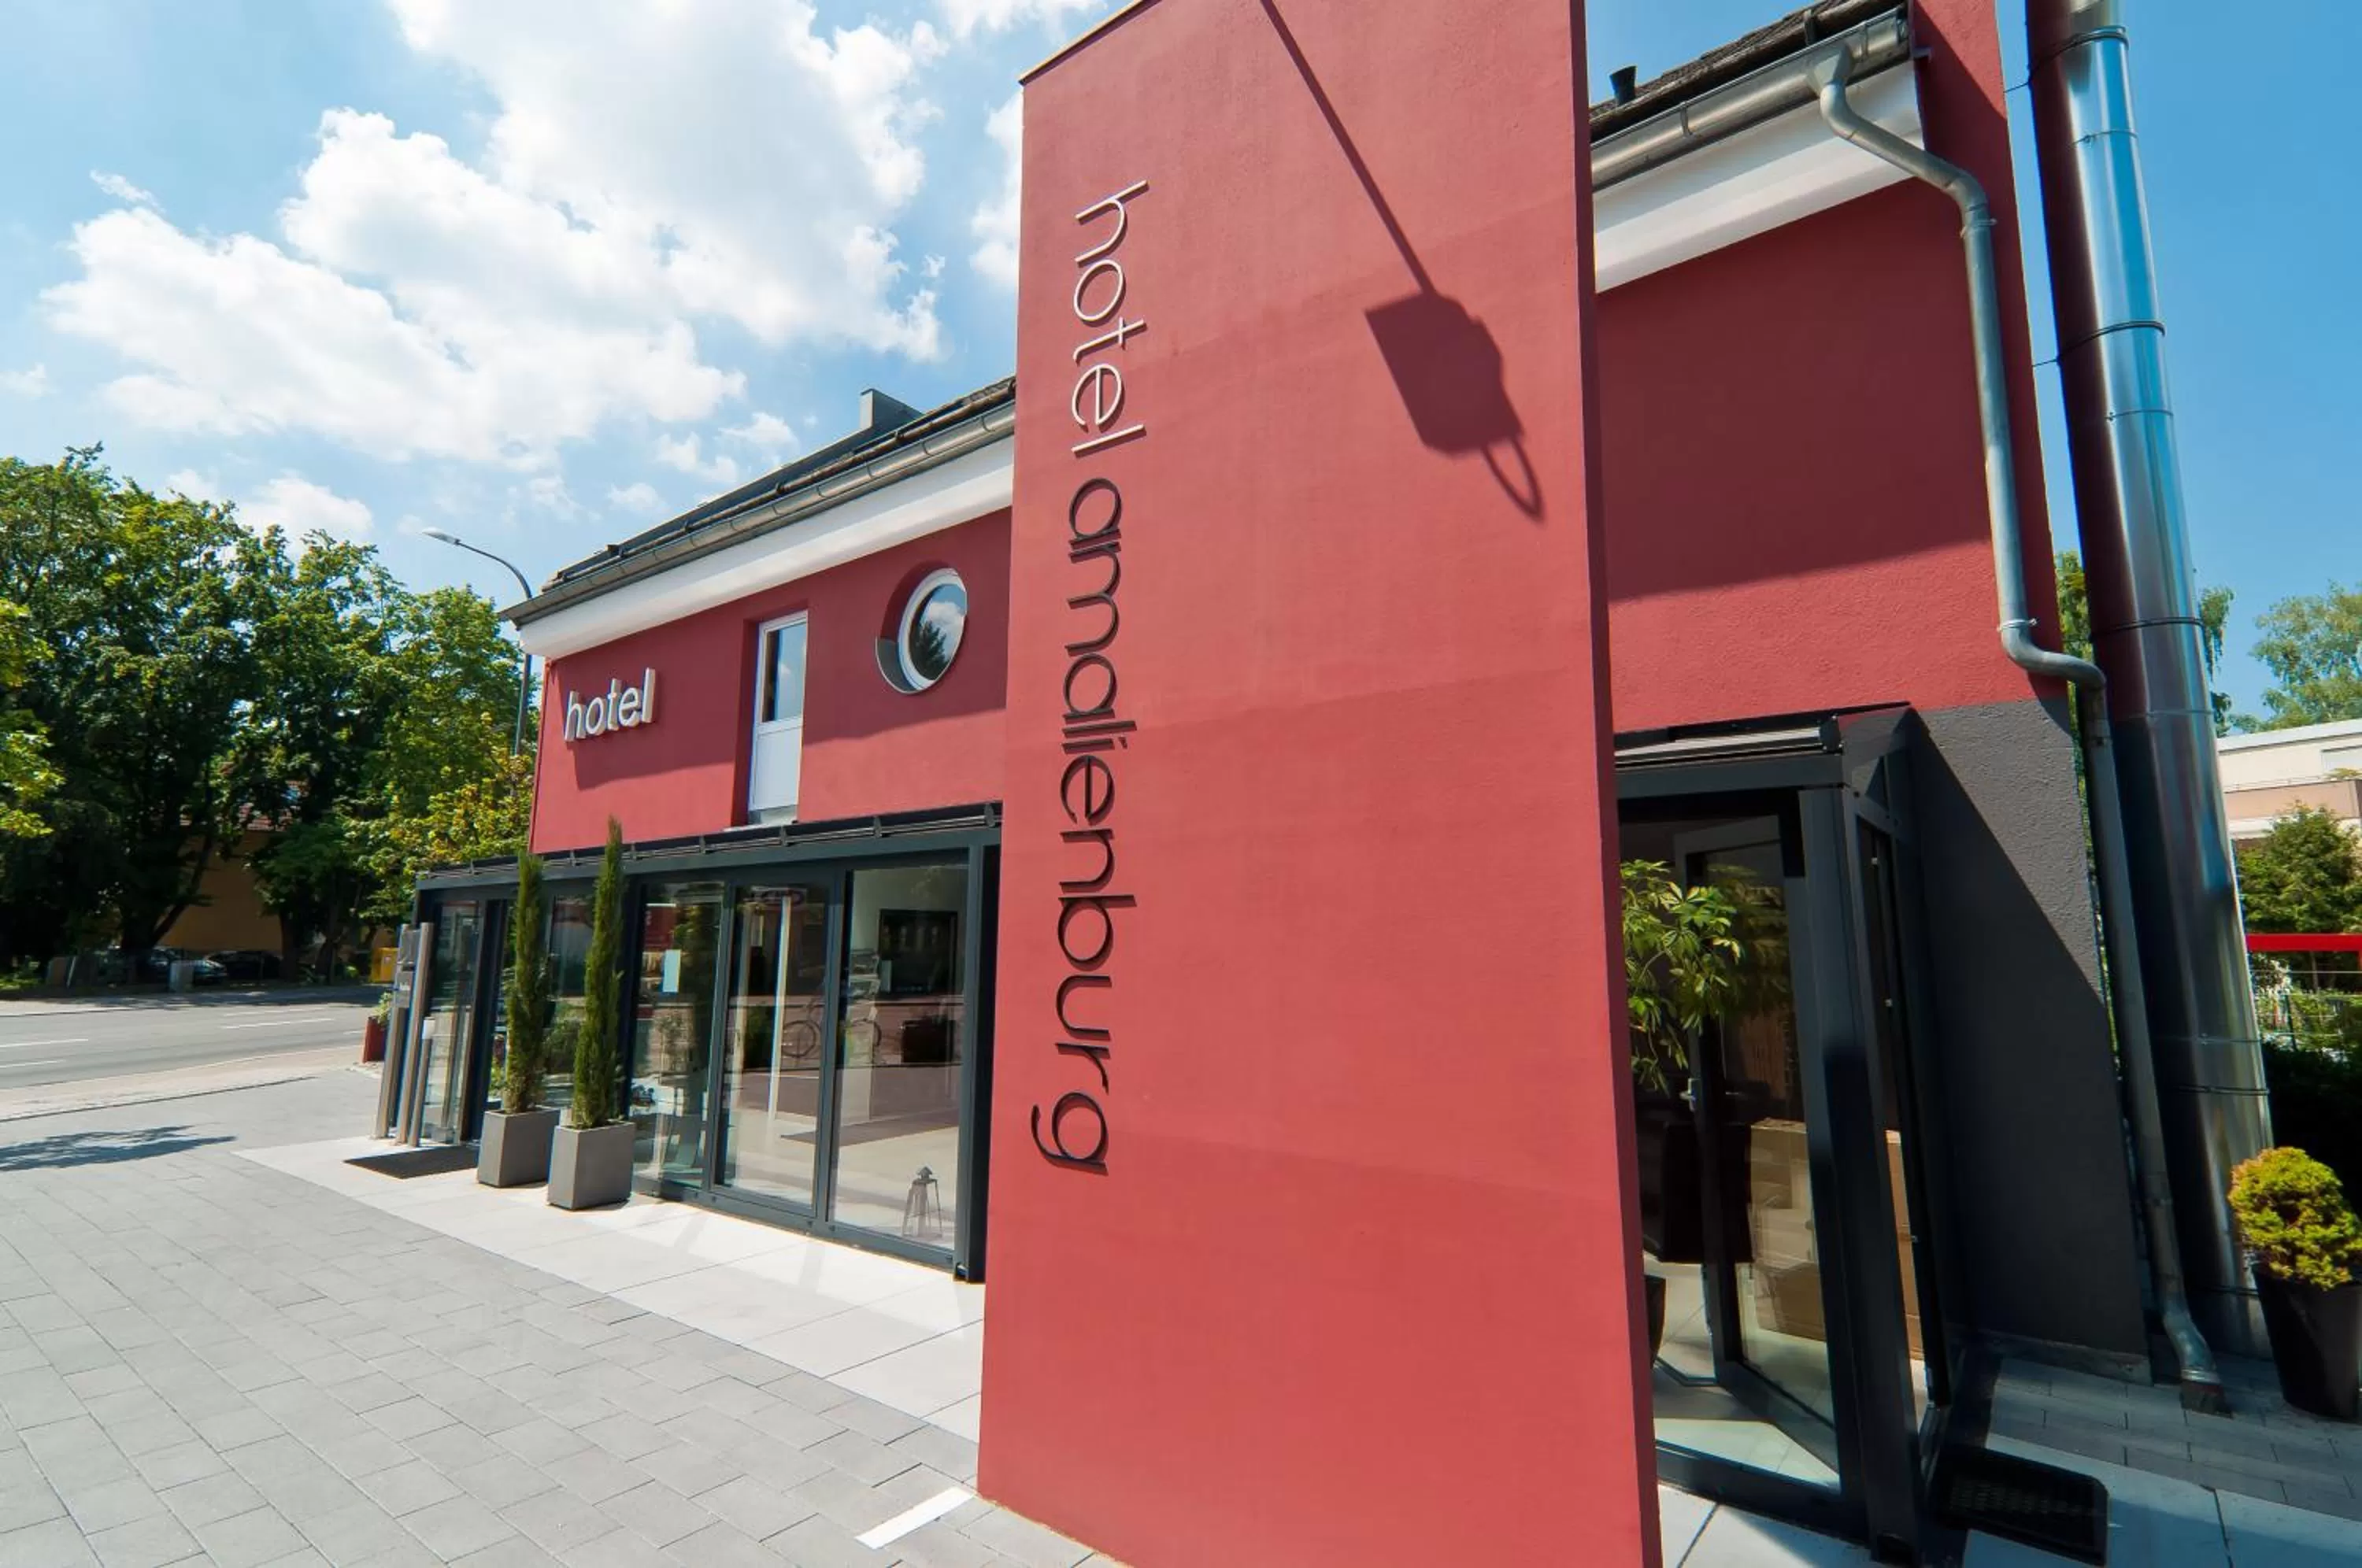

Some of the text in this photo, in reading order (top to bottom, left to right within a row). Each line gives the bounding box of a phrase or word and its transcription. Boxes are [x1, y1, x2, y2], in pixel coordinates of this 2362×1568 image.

[565, 668, 655, 741] hotel
[1031, 179, 1148, 1174] hotel amalienburg
